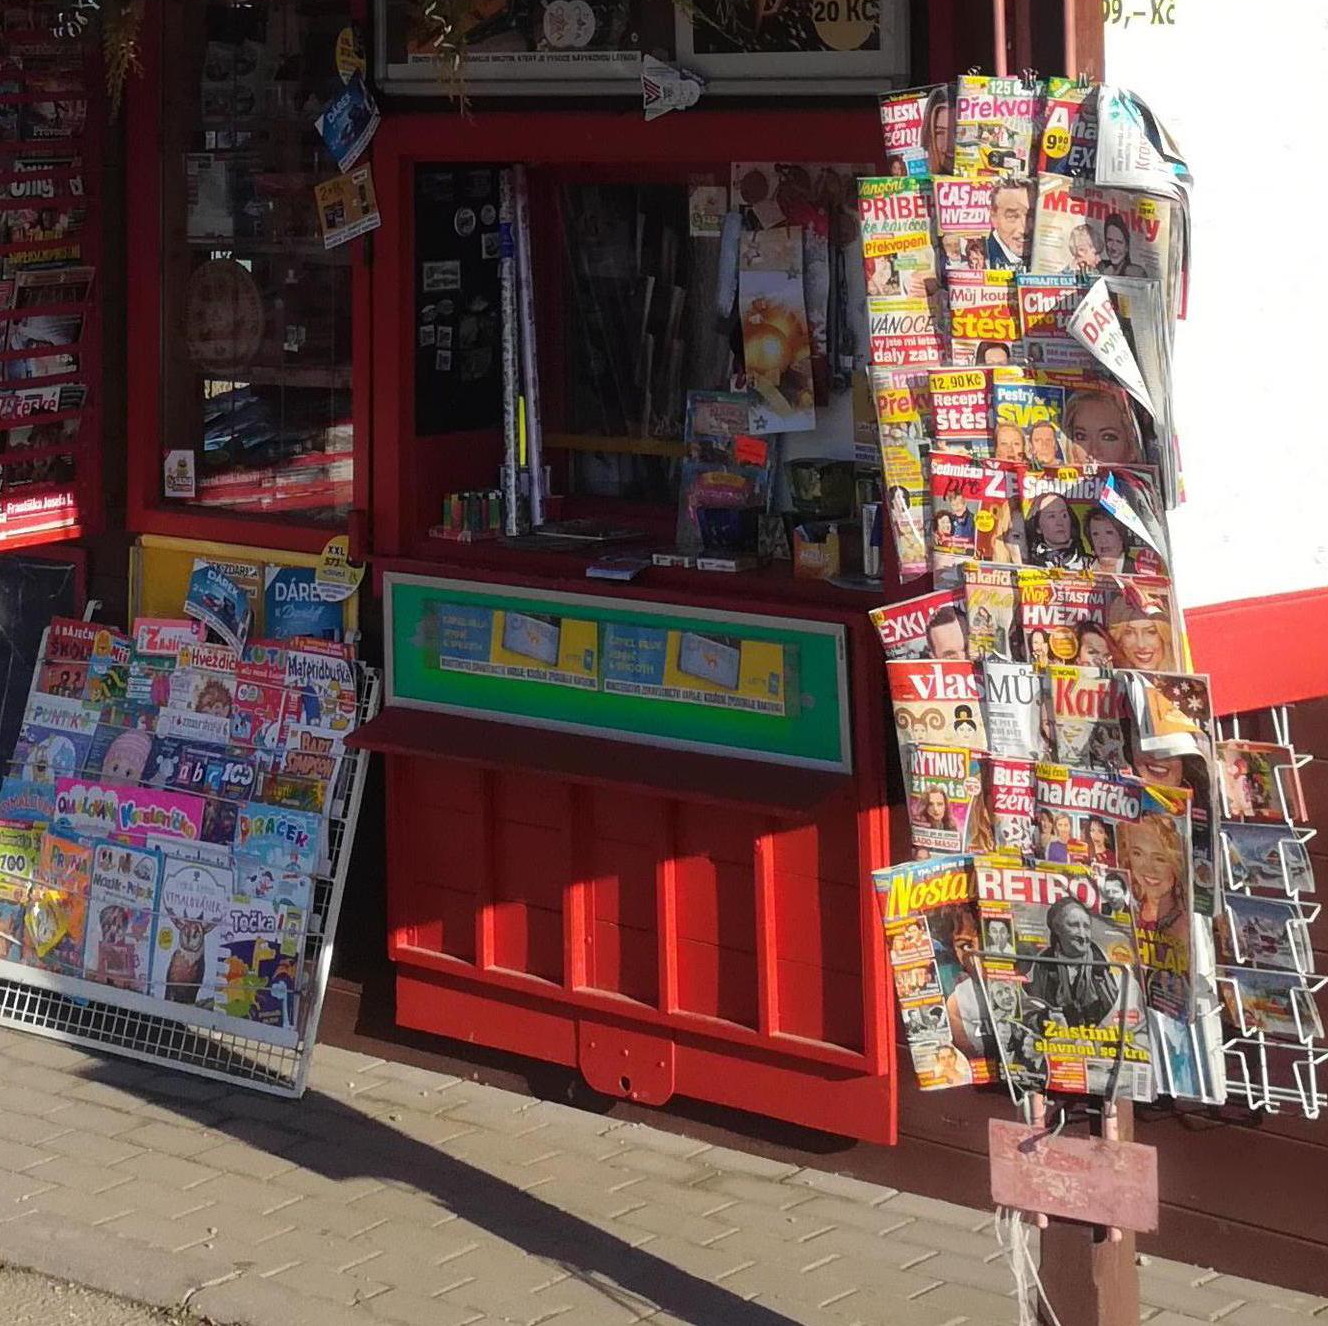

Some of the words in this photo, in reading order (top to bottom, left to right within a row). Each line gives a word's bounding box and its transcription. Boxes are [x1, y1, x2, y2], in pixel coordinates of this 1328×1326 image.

[814, 1, 840, 22] 20
[880, 103, 919, 125] BLESK
[939, 181, 970, 207] ČAS
[951, 287, 976, 305] Můj
[871, 312, 937, 335] VÁNOCE
[967, 372, 982, 386] Kč
[934, 392, 985, 408] Recept
[997, 387, 1034, 405] Pestrý
[930, 462, 983, 479] Sedmička
[6, 498, 43, 514] Františka
[327, 545, 346, 557] XXL
[207, 570, 239, 598] DÁREK
[912, 752, 965, 781] RYTMUS
[1038, 780, 1063, 806] na
[1066, 778, 1140, 819] kafíčko
[888, 869, 969, 918] Nosta
[977, 868, 1097, 910] RETRO
[1034, 1039, 1097, 1057] slavnou
[1099, 1045, 1152, 1062] setru
